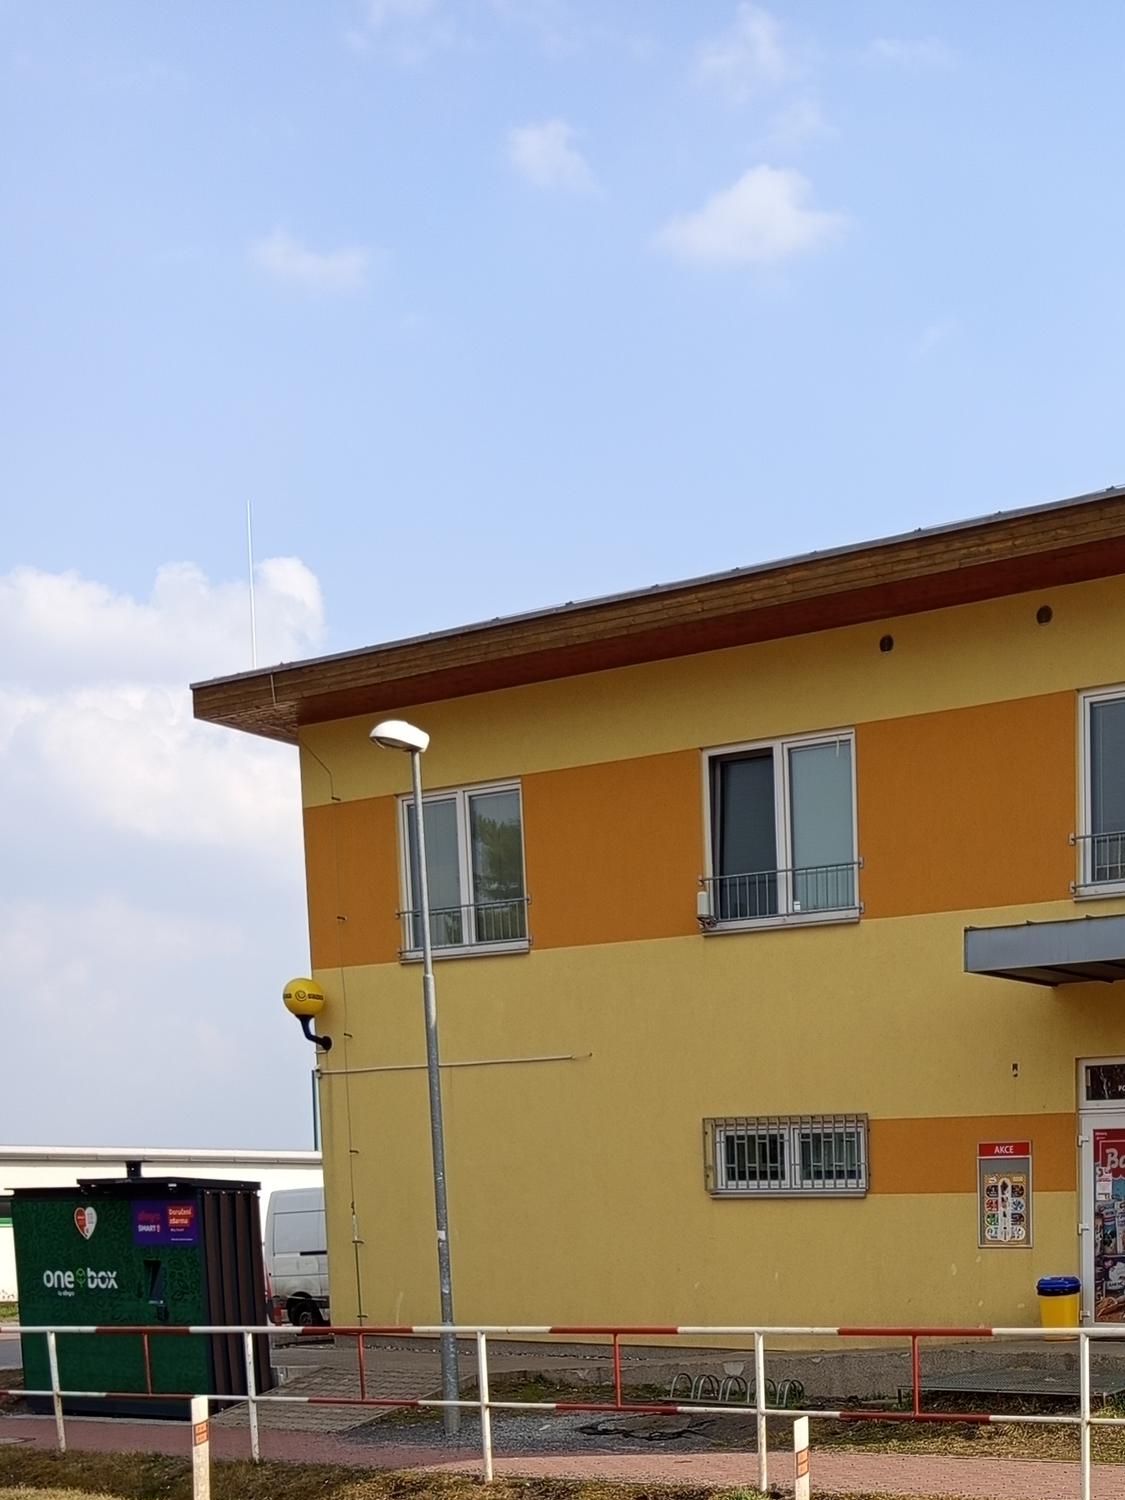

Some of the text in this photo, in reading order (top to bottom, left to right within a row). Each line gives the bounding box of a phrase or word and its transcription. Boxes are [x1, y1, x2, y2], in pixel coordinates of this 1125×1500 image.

[994, 1145, 1015, 1154] AKCE
[43, 1266, 119, 1289] one box
